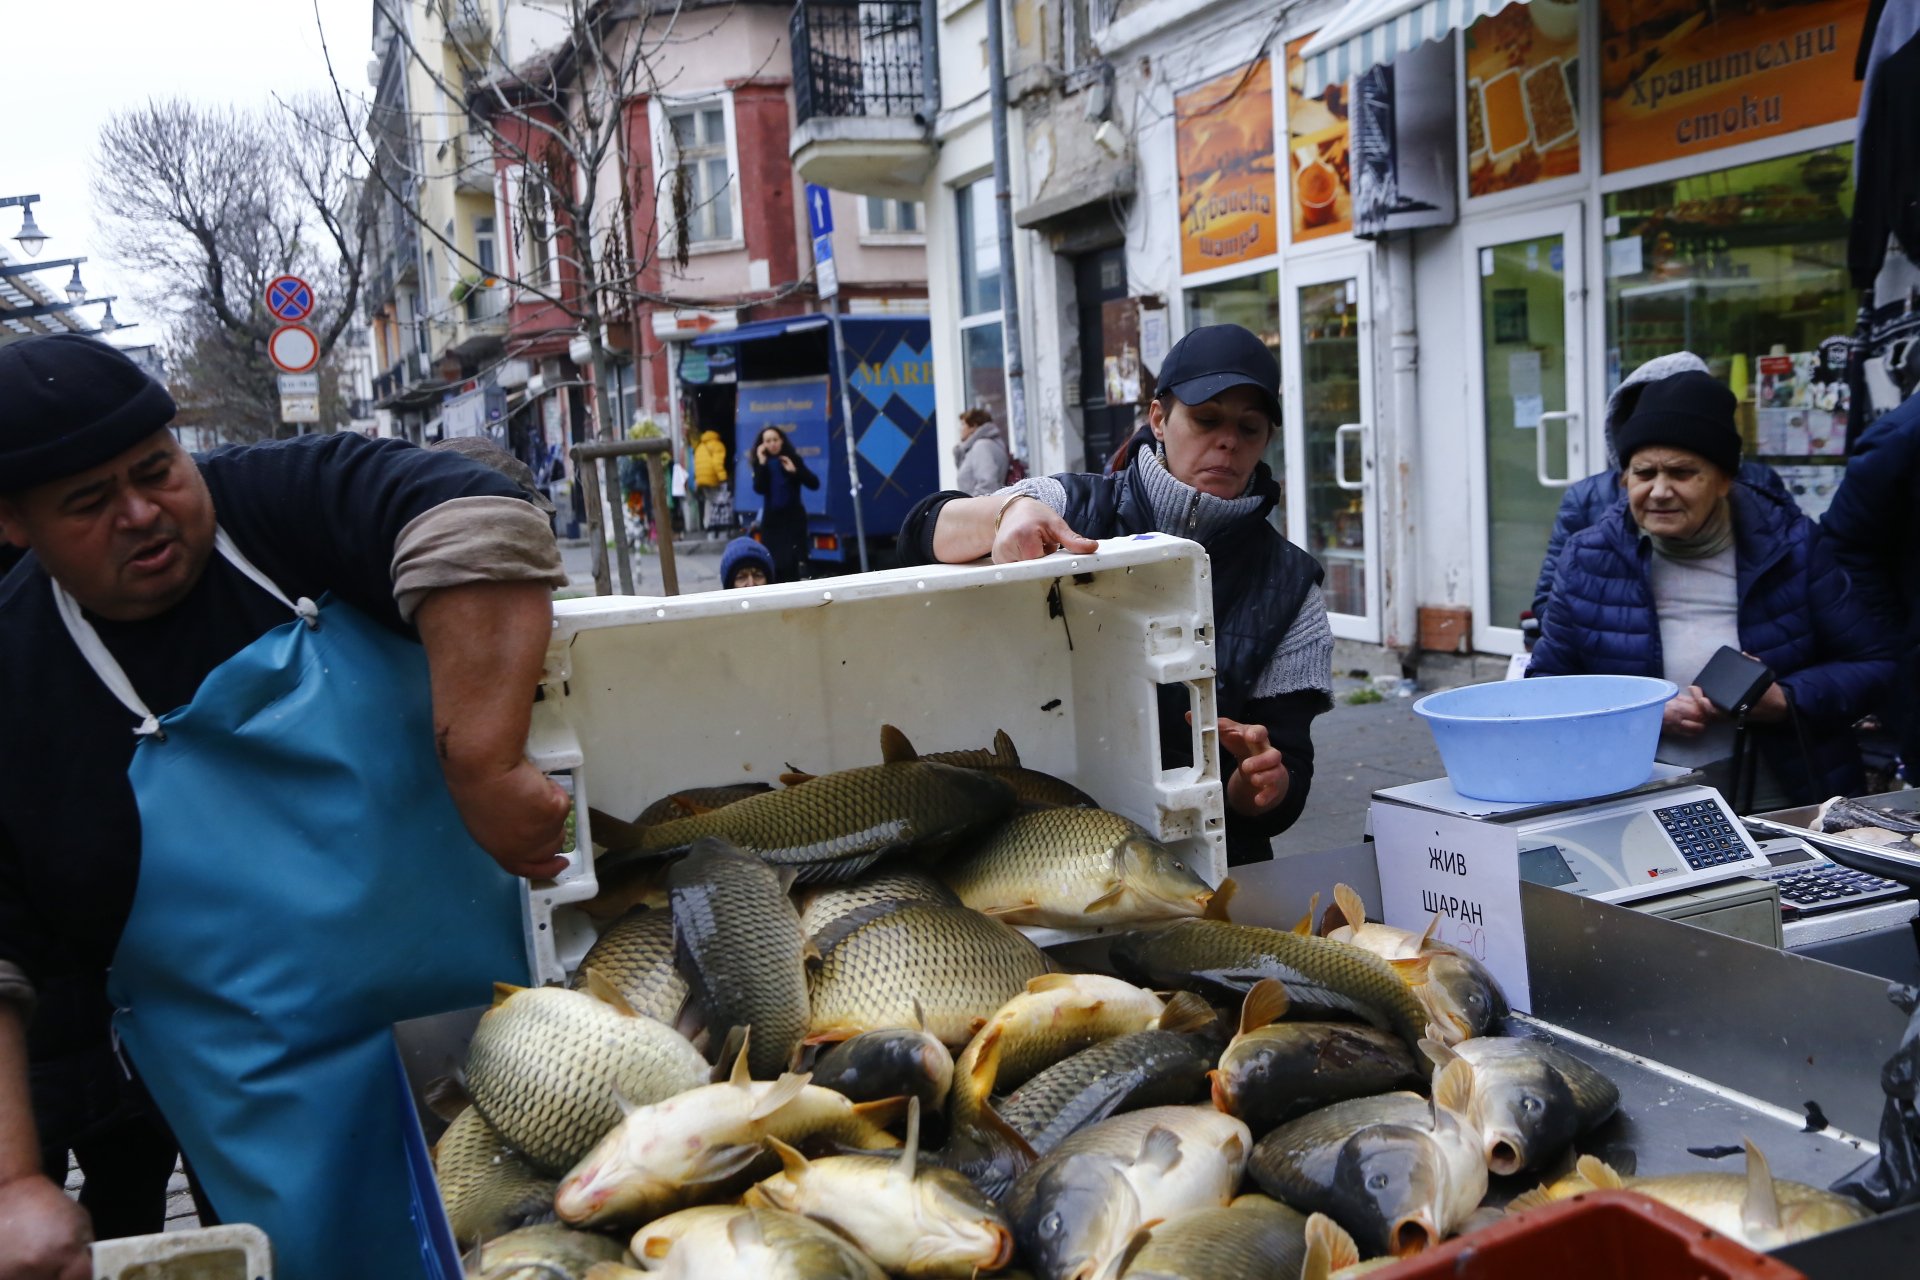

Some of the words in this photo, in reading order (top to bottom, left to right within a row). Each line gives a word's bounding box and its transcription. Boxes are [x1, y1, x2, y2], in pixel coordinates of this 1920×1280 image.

[1630, 23, 1838, 109] хранителни
[1675, 94, 1783, 146] стоки
[1428, 846, 1467, 876] ЖИВ
[1422, 889, 1483, 926] ШАРАН
